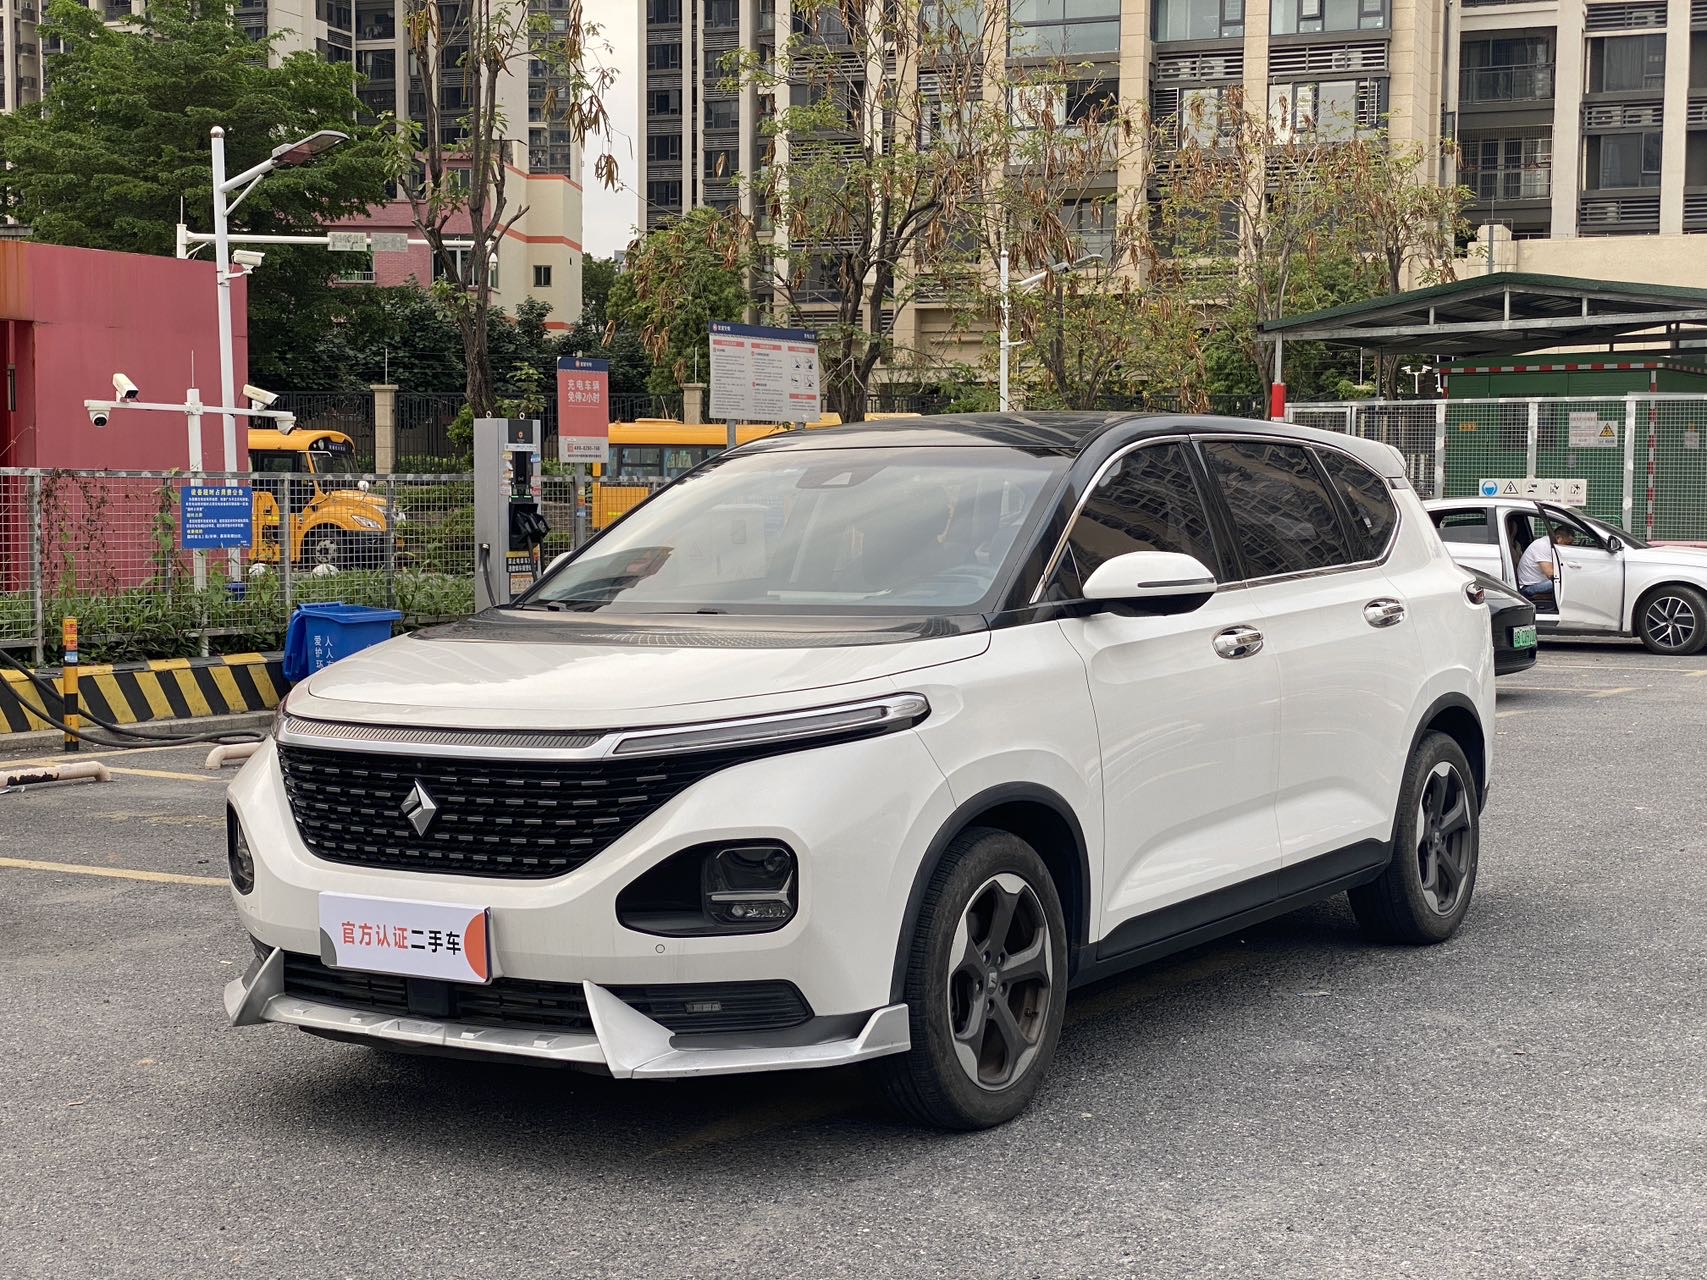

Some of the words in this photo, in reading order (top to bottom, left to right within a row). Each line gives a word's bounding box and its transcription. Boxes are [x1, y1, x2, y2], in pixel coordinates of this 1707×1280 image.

[567, 379, 600, 391] 充电车辆
[567, 392, 600, 404] 免停2小时
[341, 921, 462, 955] 官方认证二手车
